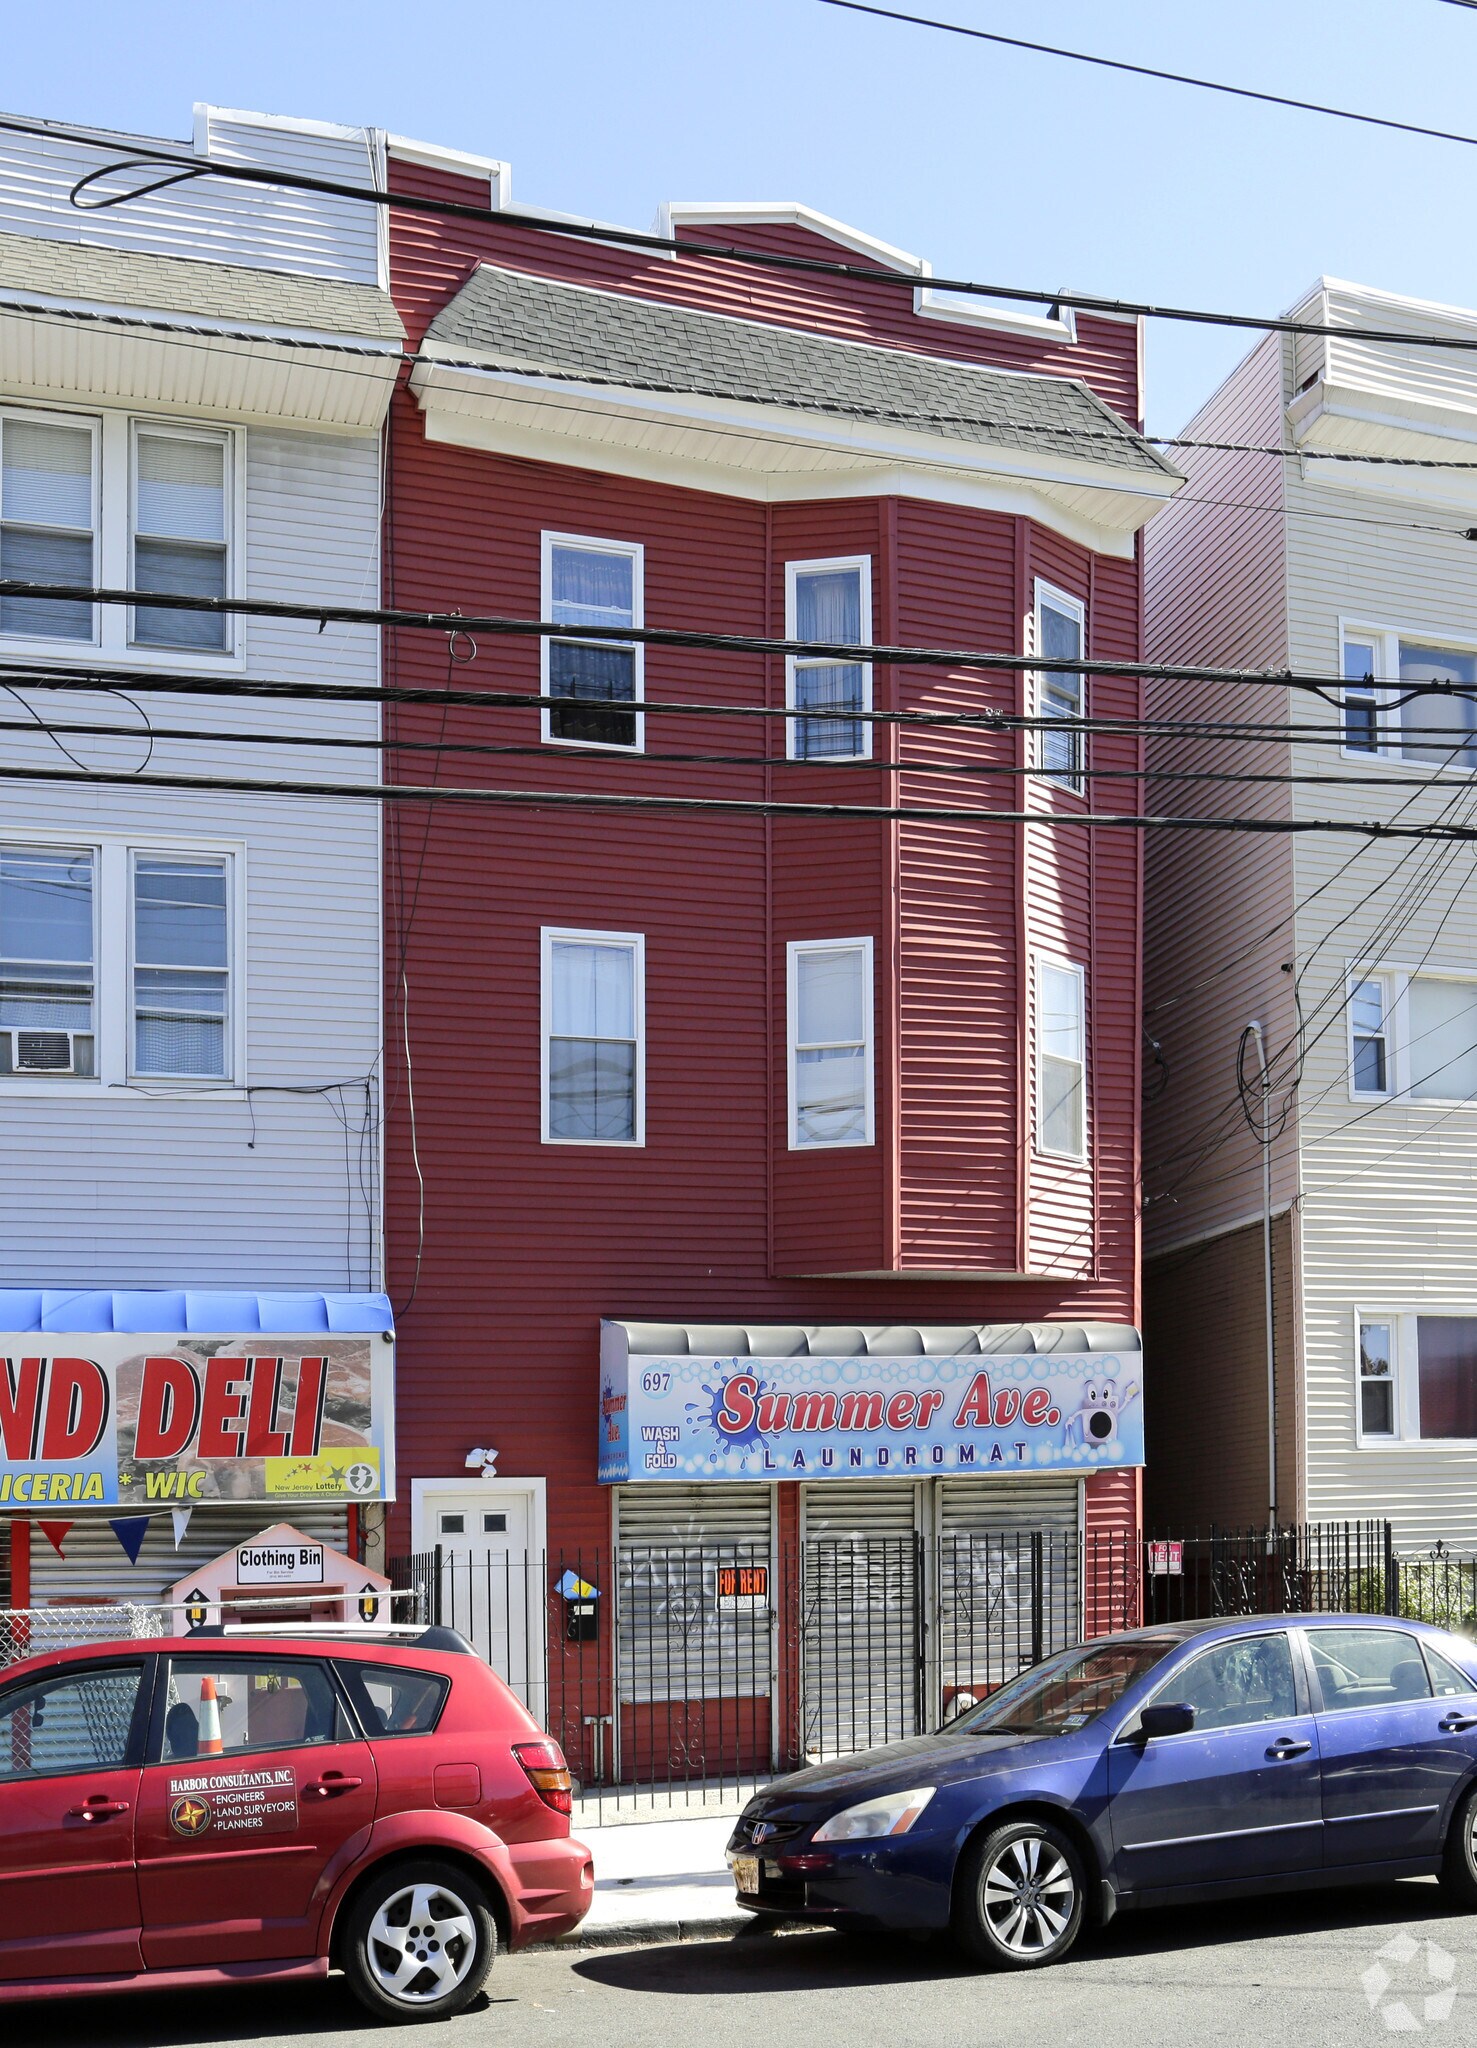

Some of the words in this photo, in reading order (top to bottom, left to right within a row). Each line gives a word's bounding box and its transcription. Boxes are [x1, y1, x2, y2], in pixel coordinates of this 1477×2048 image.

[643, 1372, 671, 1392] 697
[133, 1356, 329, 1460] DELI
[717, 1373, 944, 1434] Summer
[953, 1370, 1061, 1428] Ave.
[641, 1426, 680, 1441] WASH
[656, 1440, 666, 1454] &
[764, 1442, 1026, 1469] LAUNDROMAT
[645, 1453, 677, 1468] FOLD
[0, 1473, 104, 1501] ICERIA
[146, 1471, 206, 1498] WIC
[316, 1482, 342, 1490] Lottery
[240, 1549, 295, 1569] Clothing
[299, 1549, 321, 1565] Bin
[740, 1568, 766, 1594] RENT
[171, 1778, 209, 1792] HARBOR
[209, 1772, 275, 1788] CONSULTANTS,
[275, 1770, 293, 1783] INC.
[216, 1791, 265, 1804] ENGINEERS
[217, 1805, 242, 1817] LAND
[244, 1801, 295, 1815] SURVEYORS
[217, 1818, 263, 1830] PLANNERS
